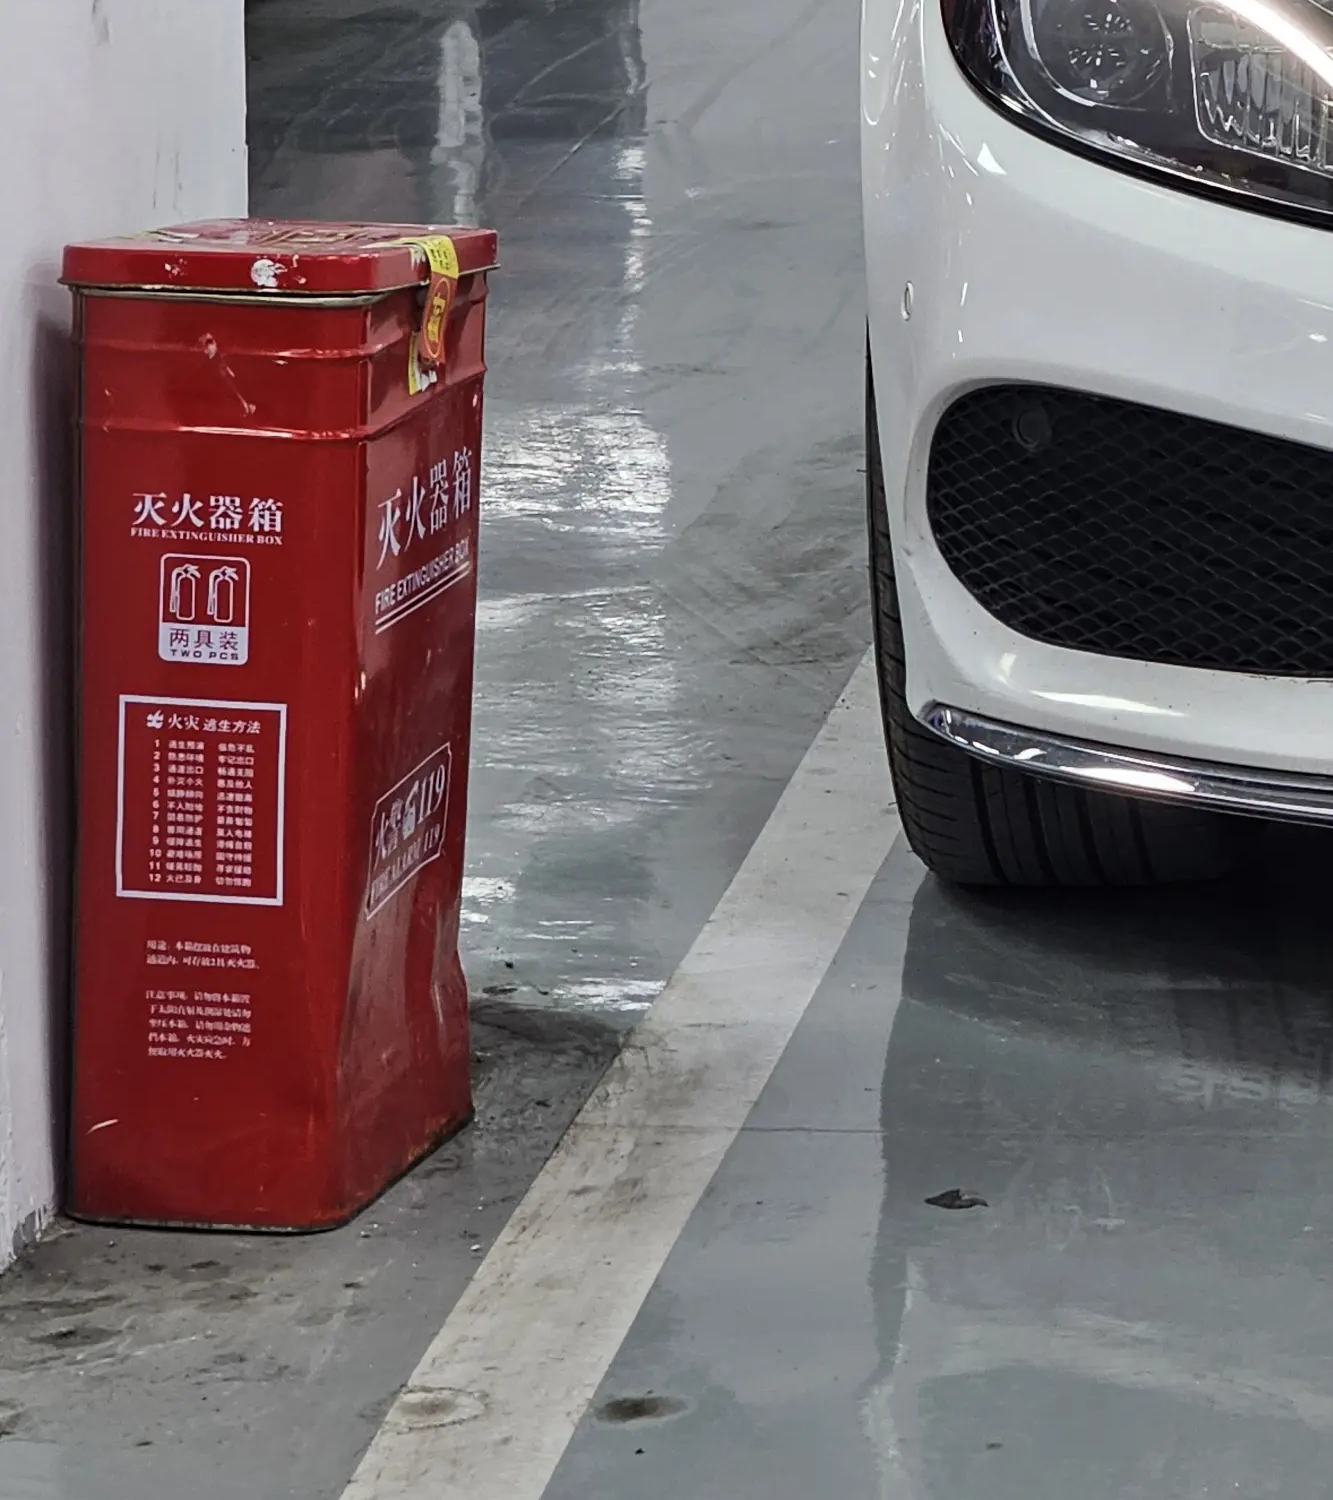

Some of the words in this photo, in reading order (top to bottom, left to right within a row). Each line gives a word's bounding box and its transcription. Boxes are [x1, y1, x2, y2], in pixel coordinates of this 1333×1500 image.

[132, 492, 284, 533] 灭火器箱
[376, 446, 472, 571] 灭火器箱
[130, 527, 160, 538] FIRE
[161, 528, 254, 544] EXTINGUISHER
[256, 535, 283, 546] BOX
[375, 583, 397, 614] FIRE
[169, 628, 239, 651] 两具装
[170, 649, 202, 658] TWO
[417, 764, 446, 825] 119
